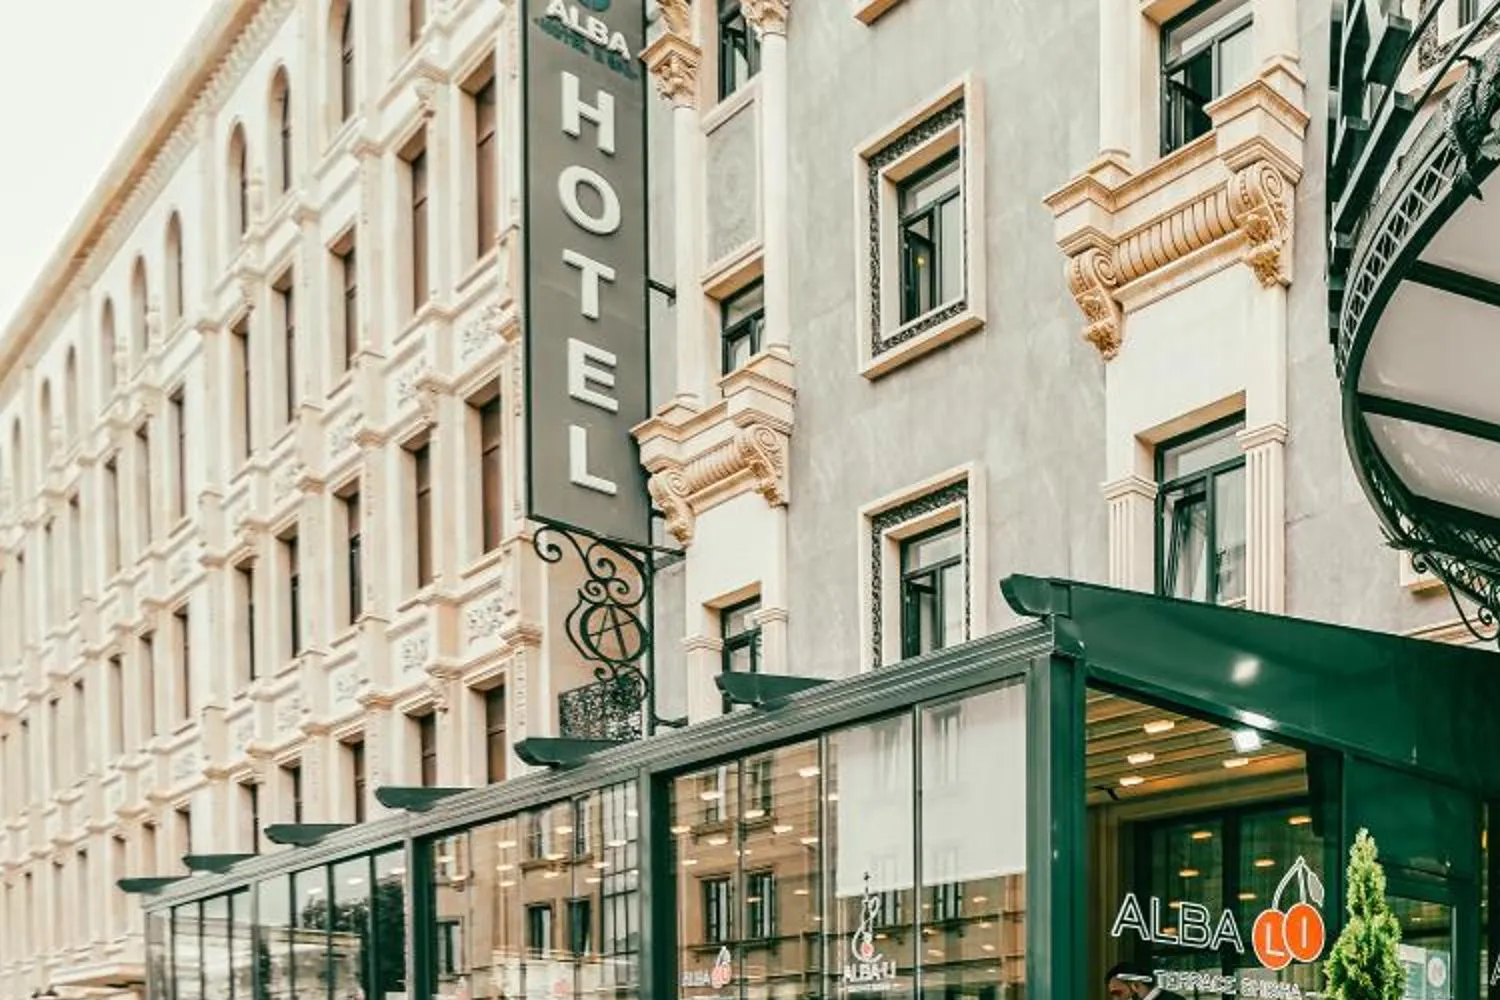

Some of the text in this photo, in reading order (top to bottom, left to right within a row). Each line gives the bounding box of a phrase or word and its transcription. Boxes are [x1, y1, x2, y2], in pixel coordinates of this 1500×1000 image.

[545, 0, 631, 60] ALBA
[557, 71, 622, 496] HOTEL
[1111, 893, 1245, 953] ALBA
